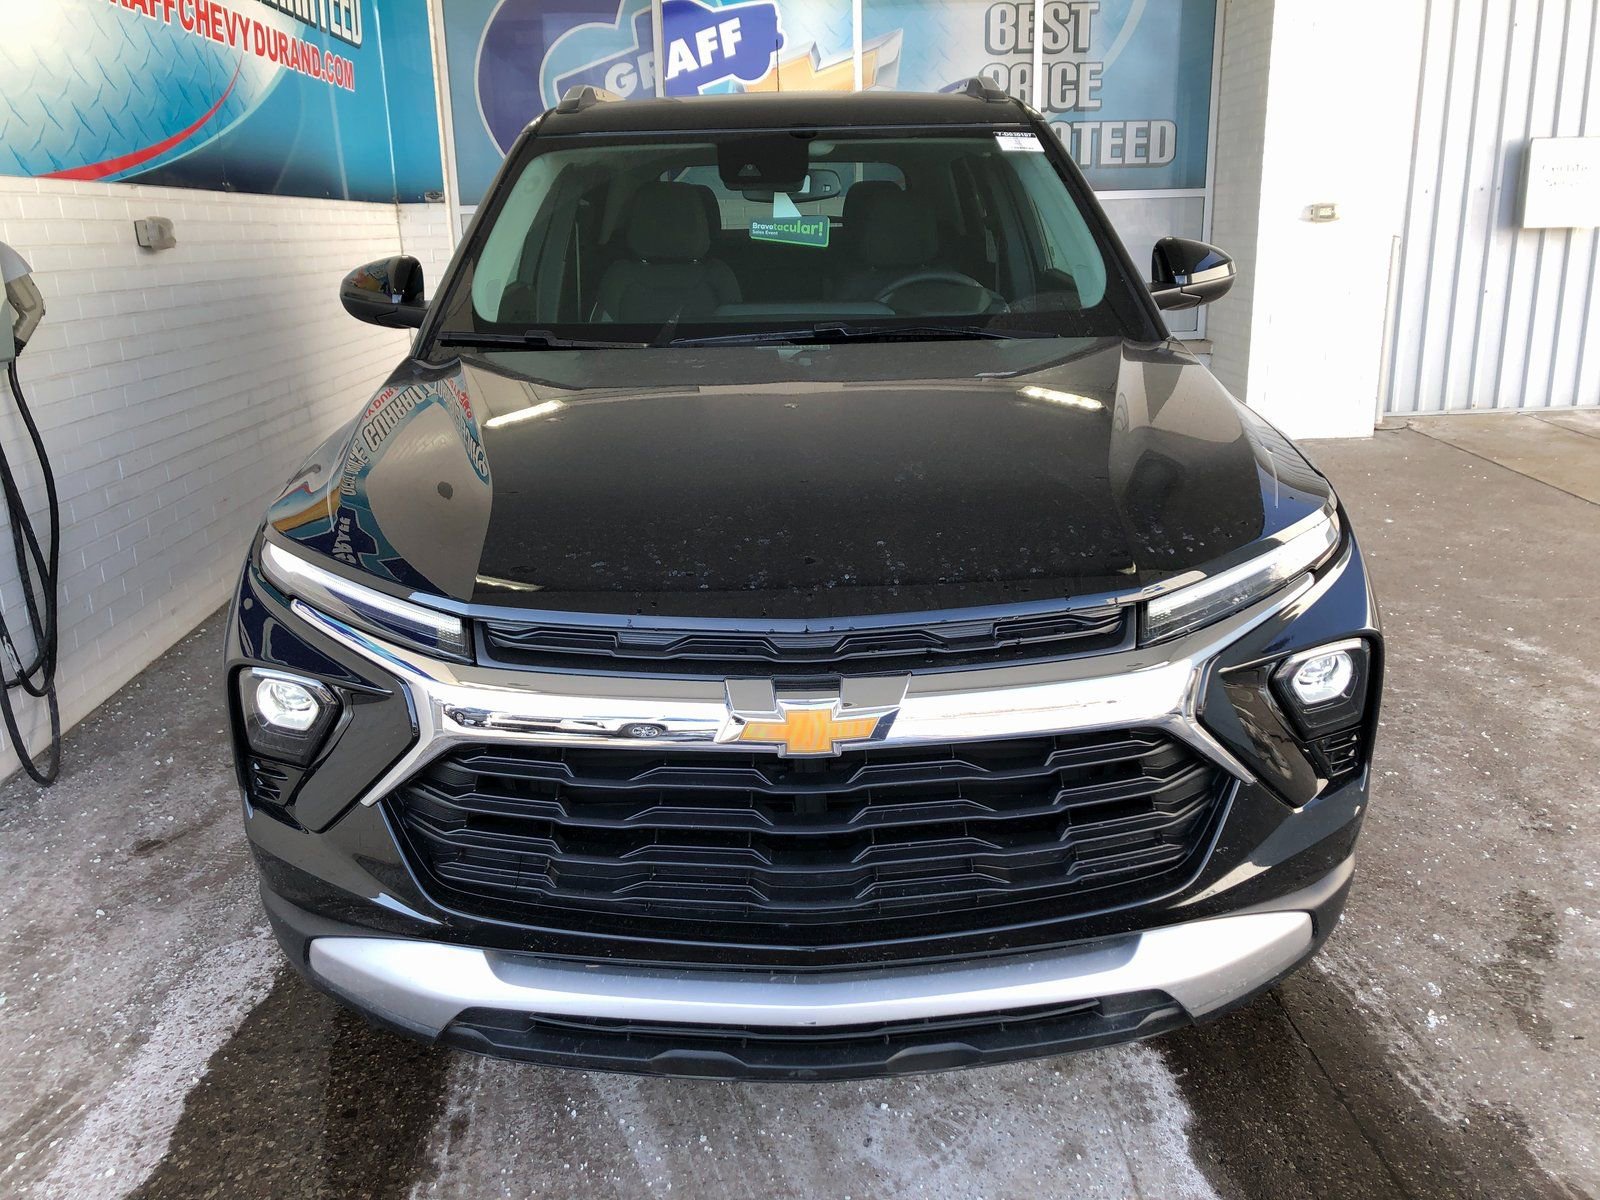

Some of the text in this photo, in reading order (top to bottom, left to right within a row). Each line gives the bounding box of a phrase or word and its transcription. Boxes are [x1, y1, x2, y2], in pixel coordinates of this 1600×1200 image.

[108, 0, 355, 91] FCHEVYDURAND.COM
[985, 2, 1100, 55] BEST
[752, 220, 824, 237] Bravotacular!
